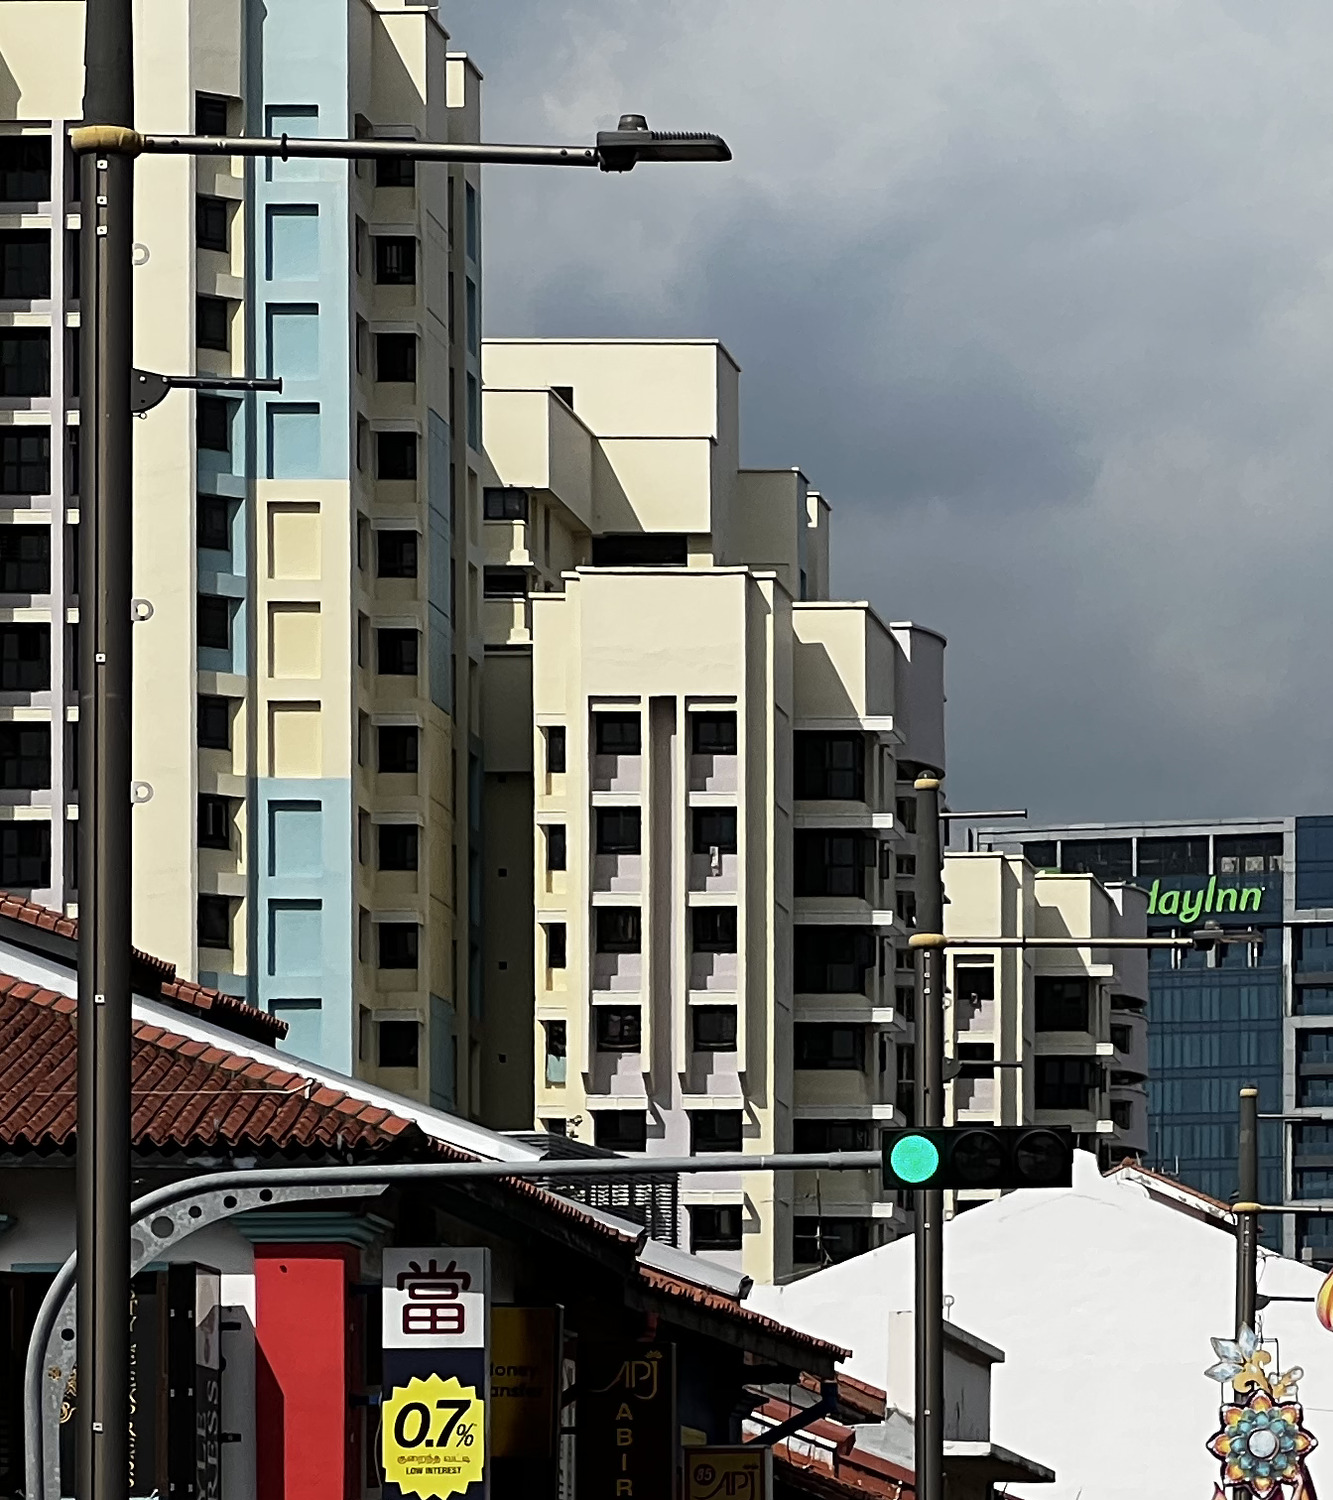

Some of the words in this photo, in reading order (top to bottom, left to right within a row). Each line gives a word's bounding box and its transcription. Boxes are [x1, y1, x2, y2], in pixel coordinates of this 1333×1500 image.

[395, 1258, 472, 1335] 當
[393, 1398, 475, 1449] 0.7%
[406, 1466, 423, 1475] LOW
[425, 1466, 461, 1474] INTEREST
